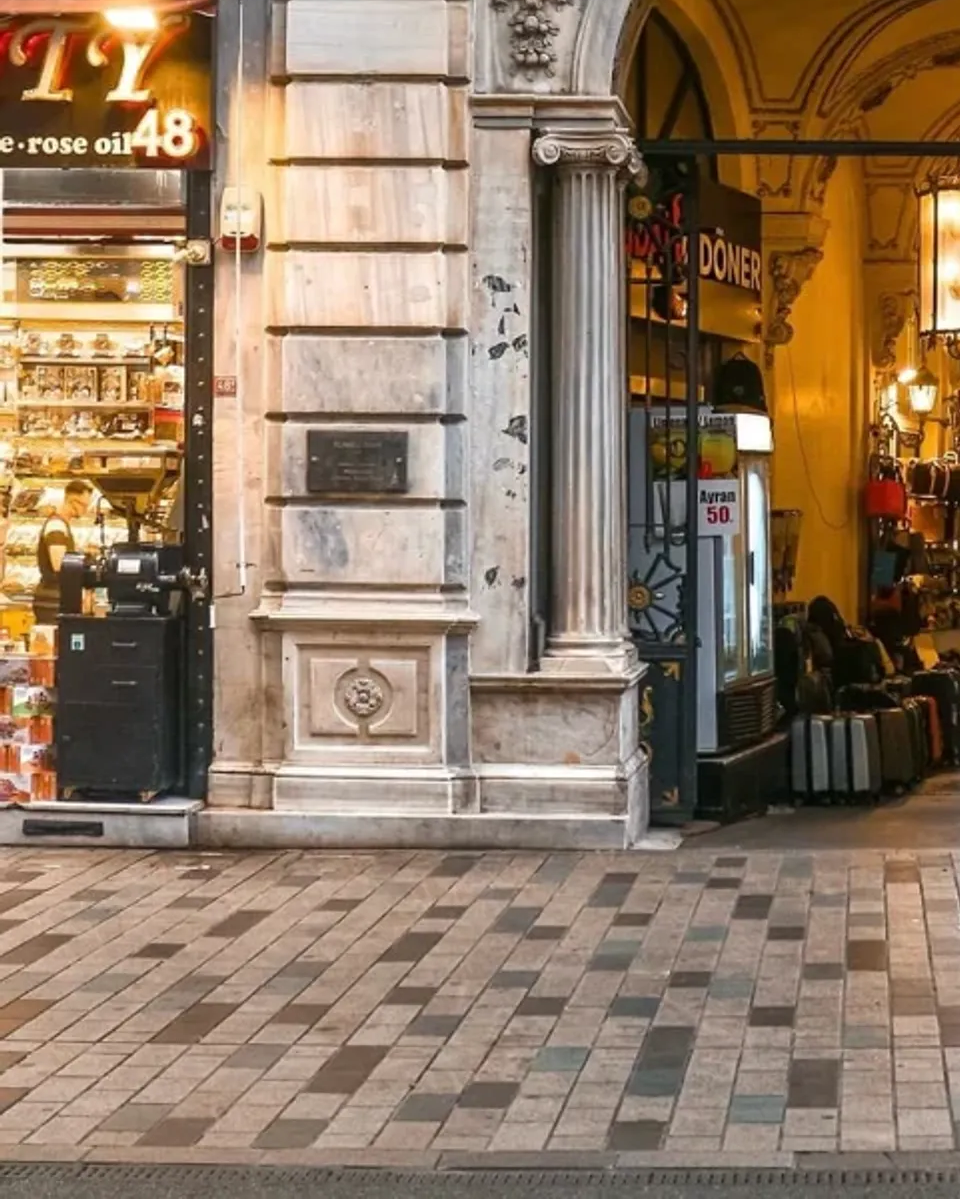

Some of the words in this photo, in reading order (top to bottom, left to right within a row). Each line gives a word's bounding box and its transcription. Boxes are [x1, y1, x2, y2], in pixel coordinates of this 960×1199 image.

[94, 131, 134, 155] oil
[132, 107, 197, 158] 48
[699, 227, 761, 291] DÖNER
[699, 489, 736, 504] Ayran
